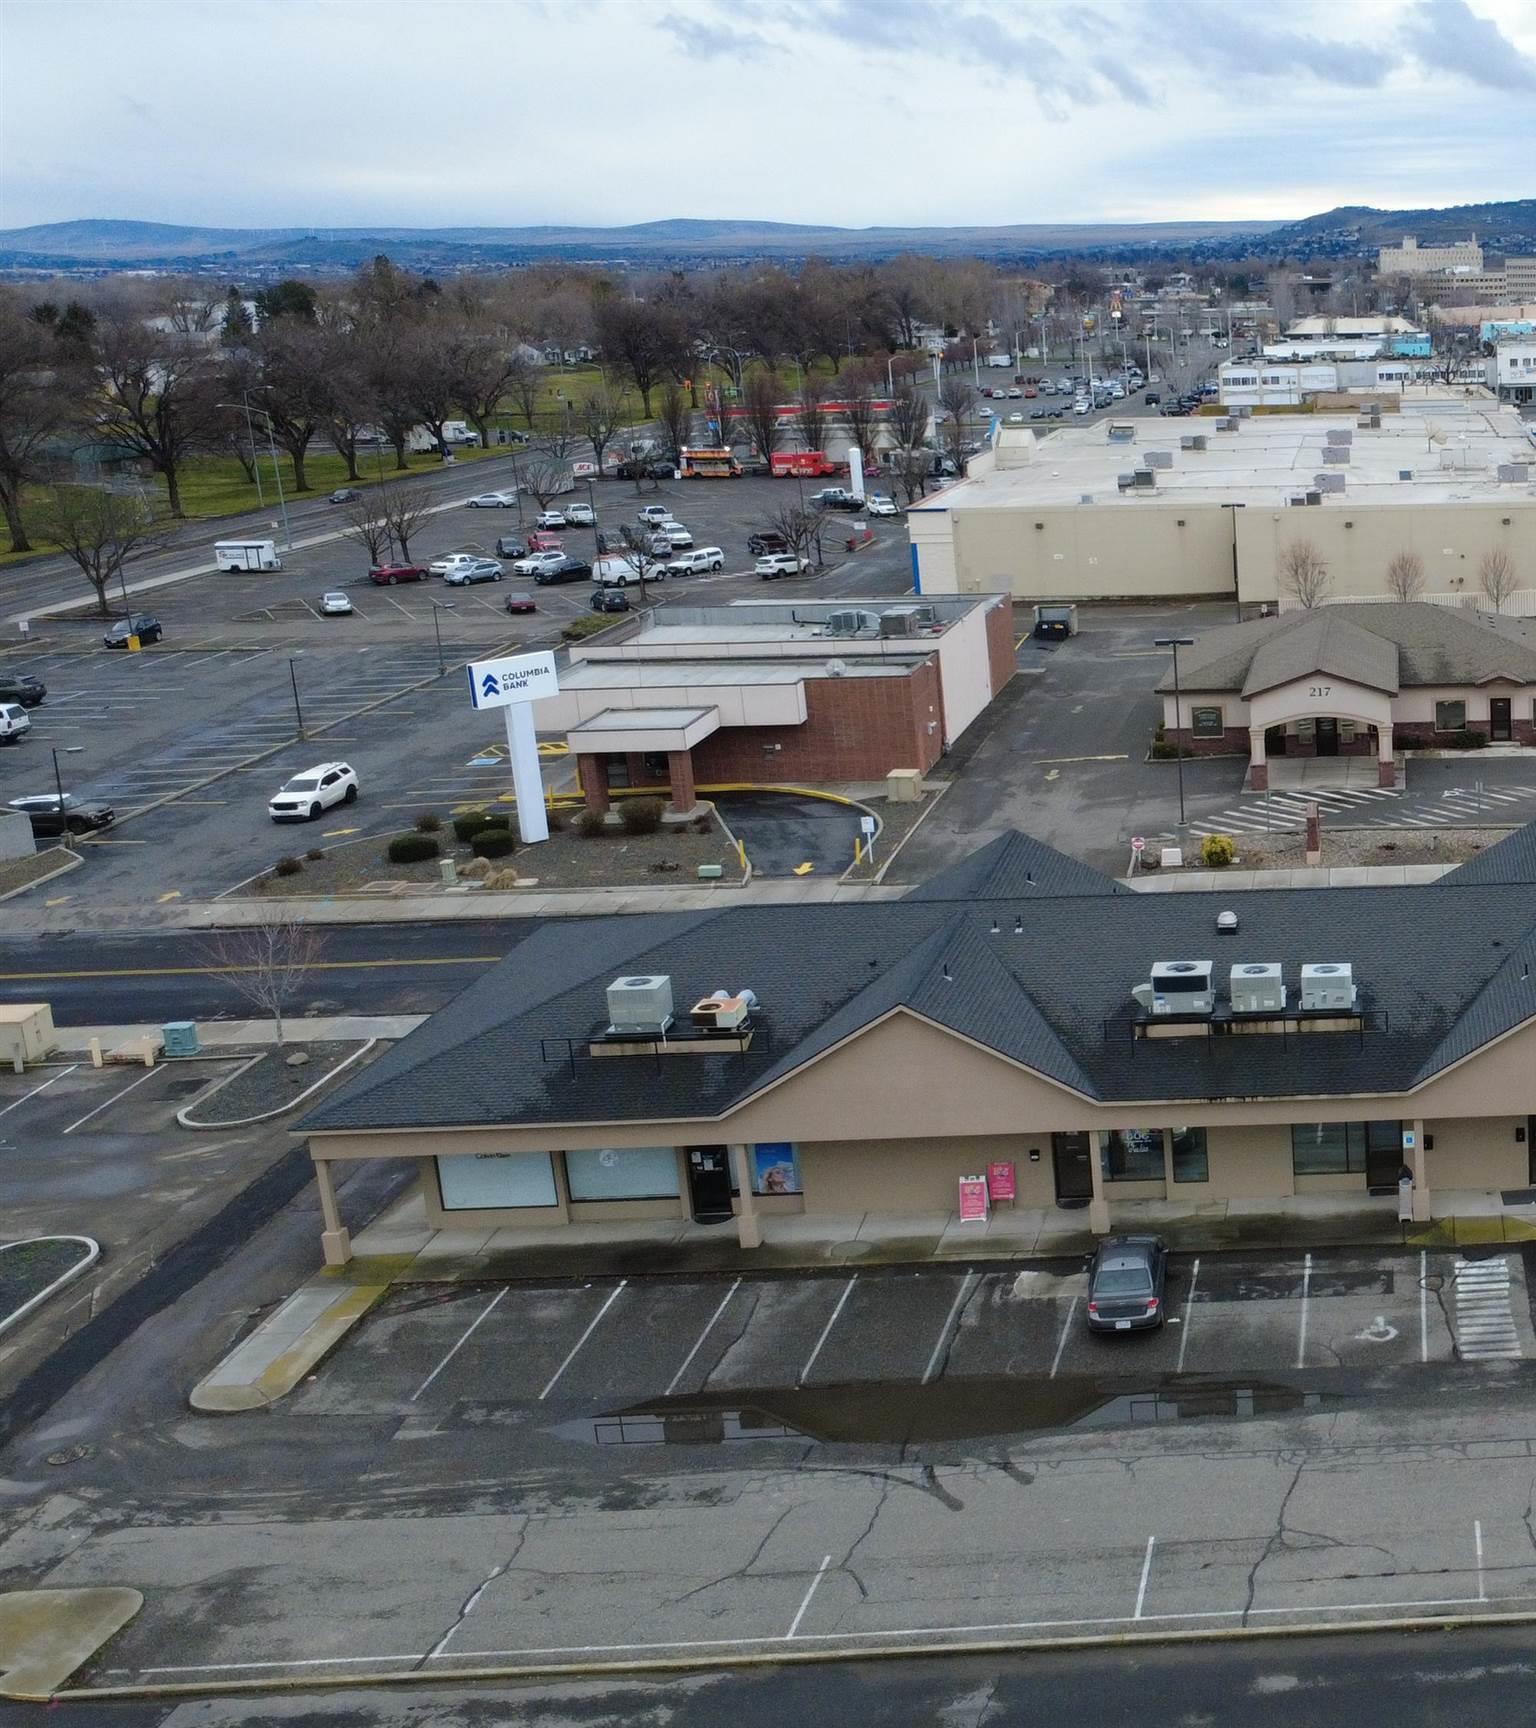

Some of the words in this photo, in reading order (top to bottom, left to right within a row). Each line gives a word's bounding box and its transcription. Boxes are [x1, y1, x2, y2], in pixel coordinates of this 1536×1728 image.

[502, 667, 550, 681] COLUMBIA
[503, 680, 528, 691] BANK
[1309, 687, 1331, 697] 217
